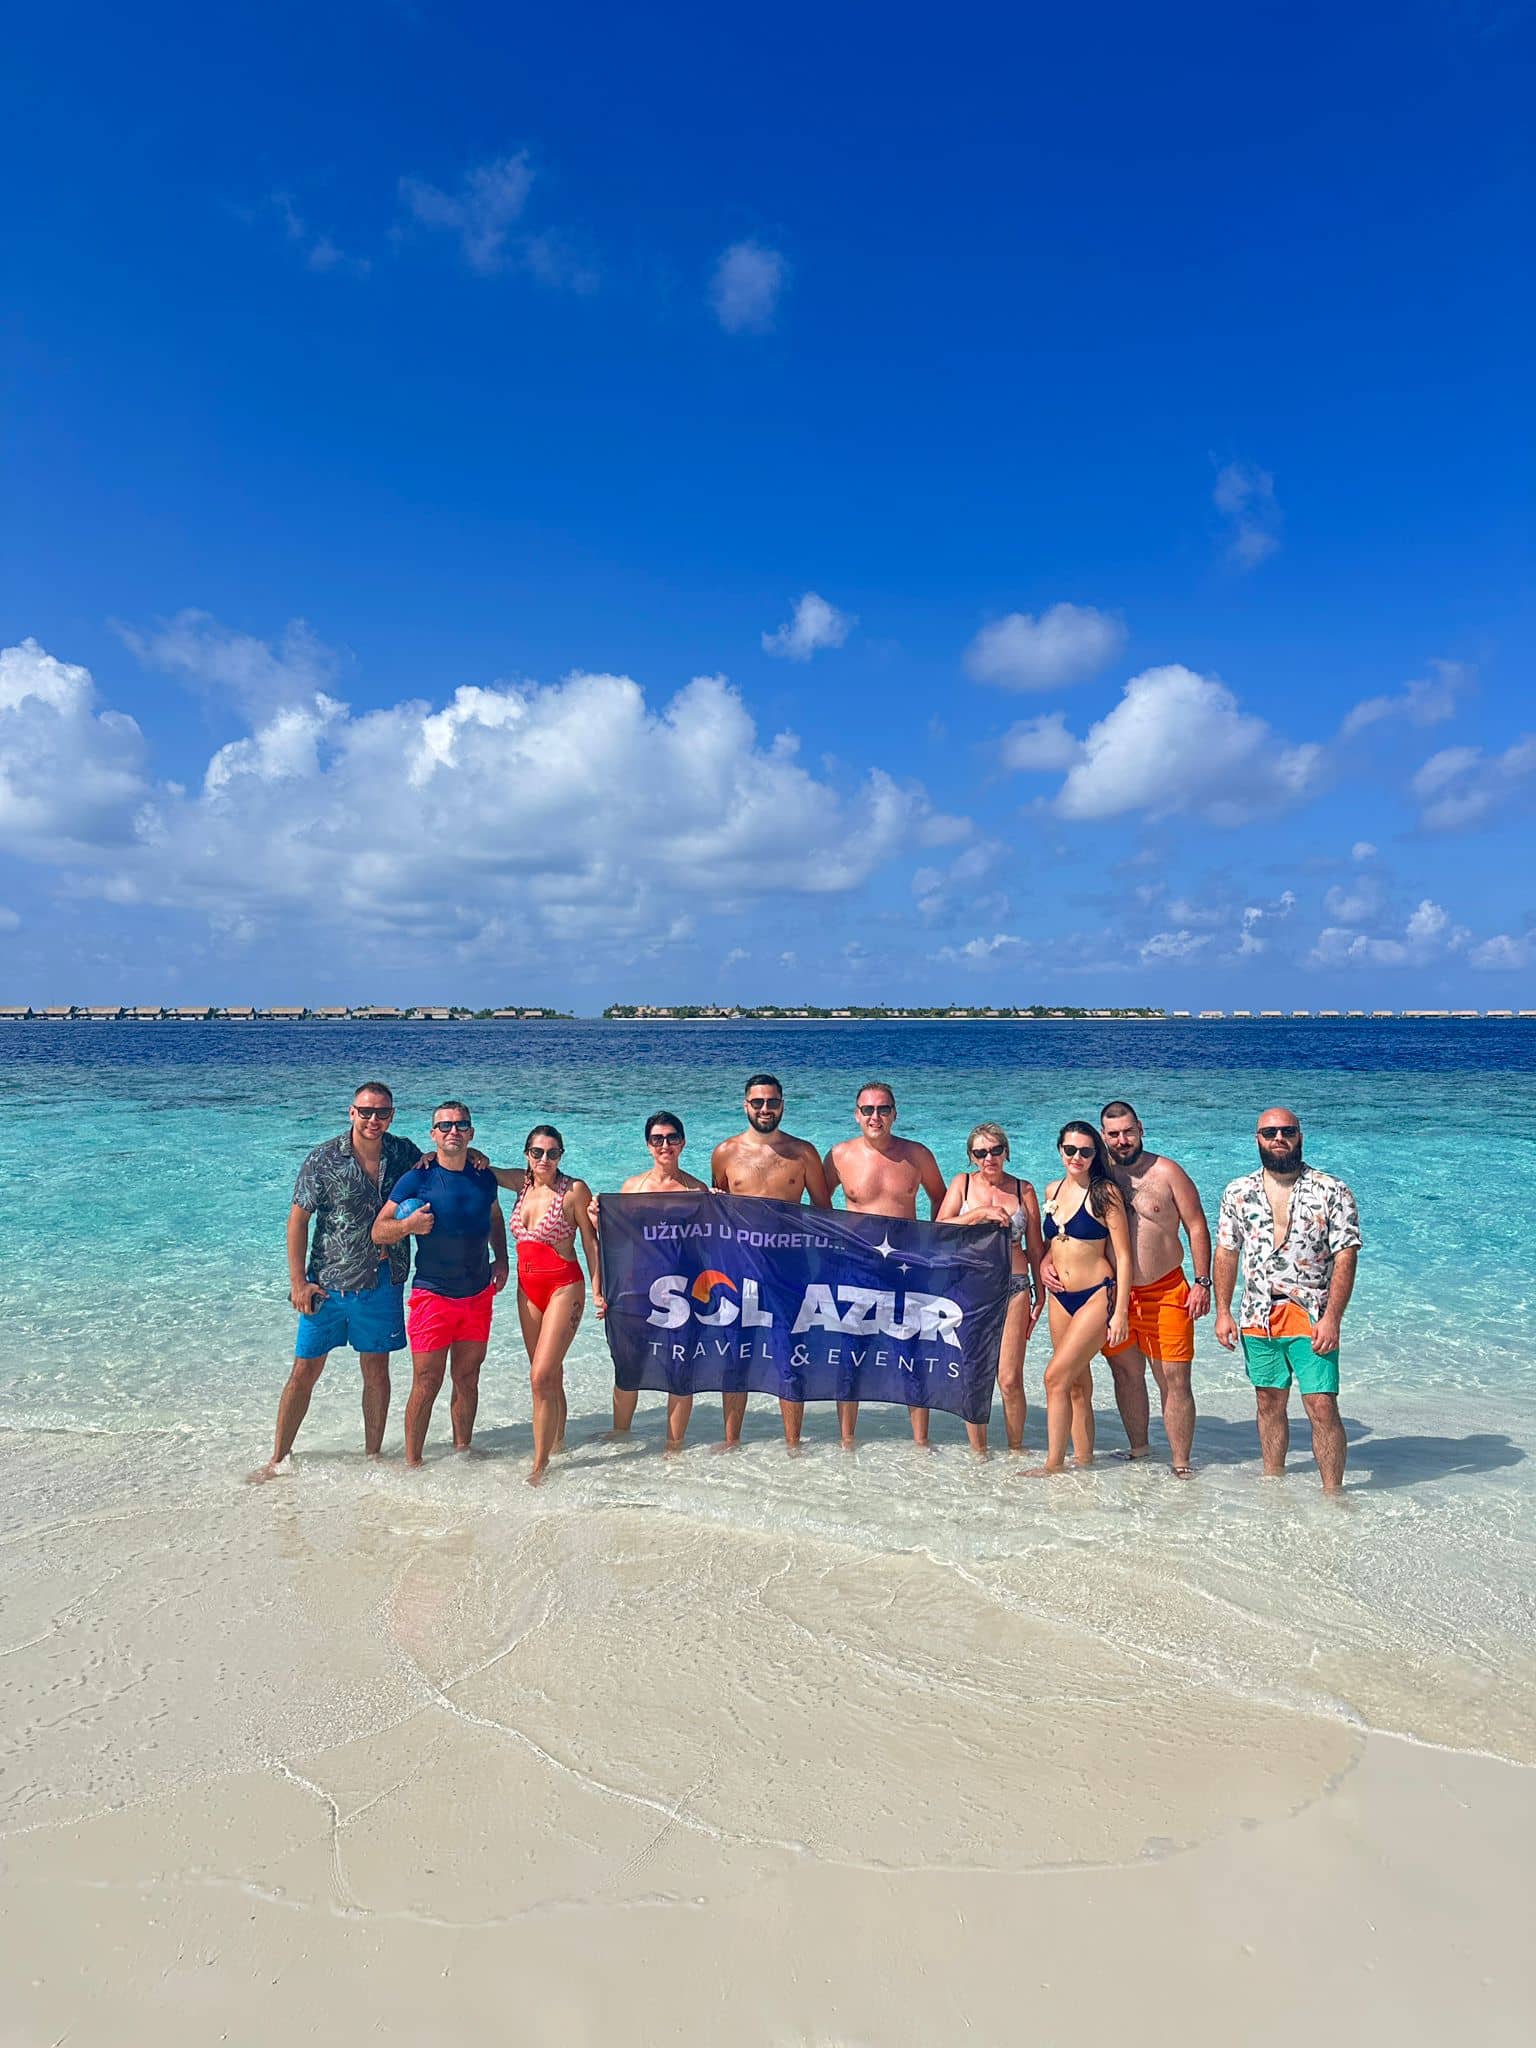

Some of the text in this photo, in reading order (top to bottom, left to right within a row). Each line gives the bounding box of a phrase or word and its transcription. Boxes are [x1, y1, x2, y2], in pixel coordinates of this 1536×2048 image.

[643, 1221, 713, 1242] UŽIVAJ
[719, 1225, 732, 1241] U
[645, 1269, 964, 1350] SOL AZUR
[648, 1342, 960, 1378] TRAVEL & EVENTS
